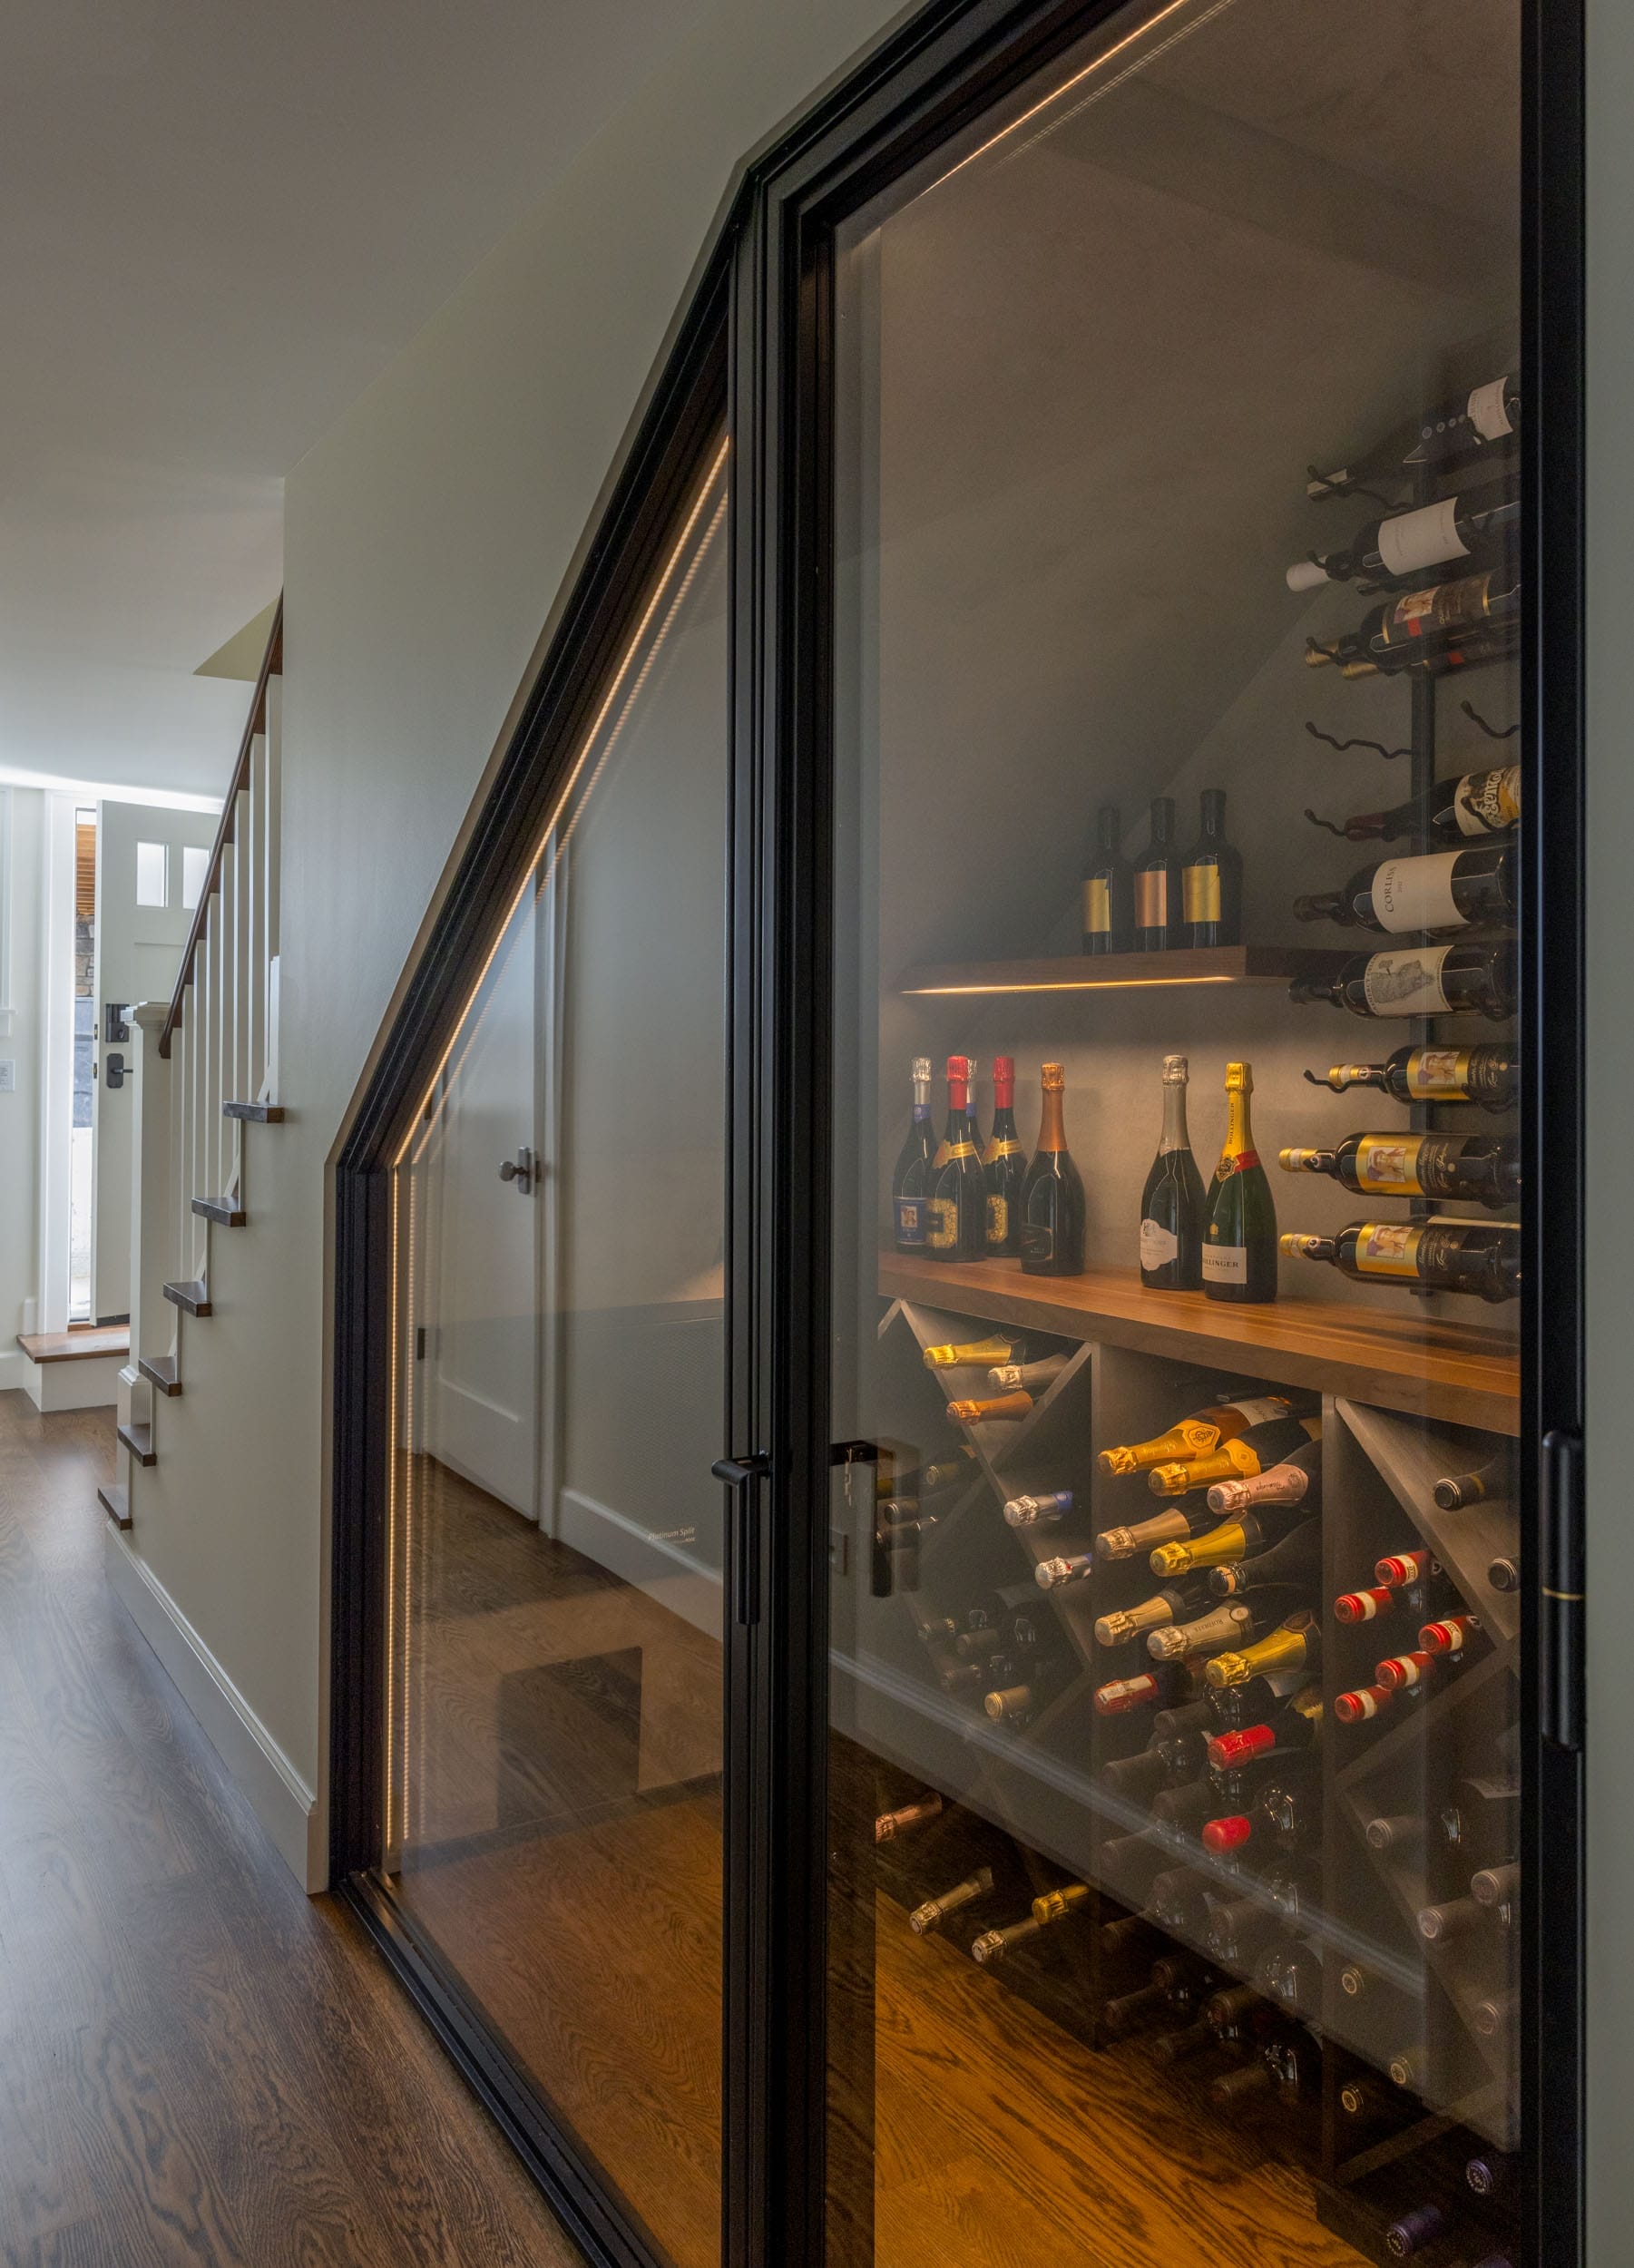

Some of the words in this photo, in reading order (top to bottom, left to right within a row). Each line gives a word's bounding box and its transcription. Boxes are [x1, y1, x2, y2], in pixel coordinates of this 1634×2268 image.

[1384, 865, 1397, 913] CORLISS
[648, 1531, 679, 1540] Platinum
[680, 1527, 695, 1537] Split
